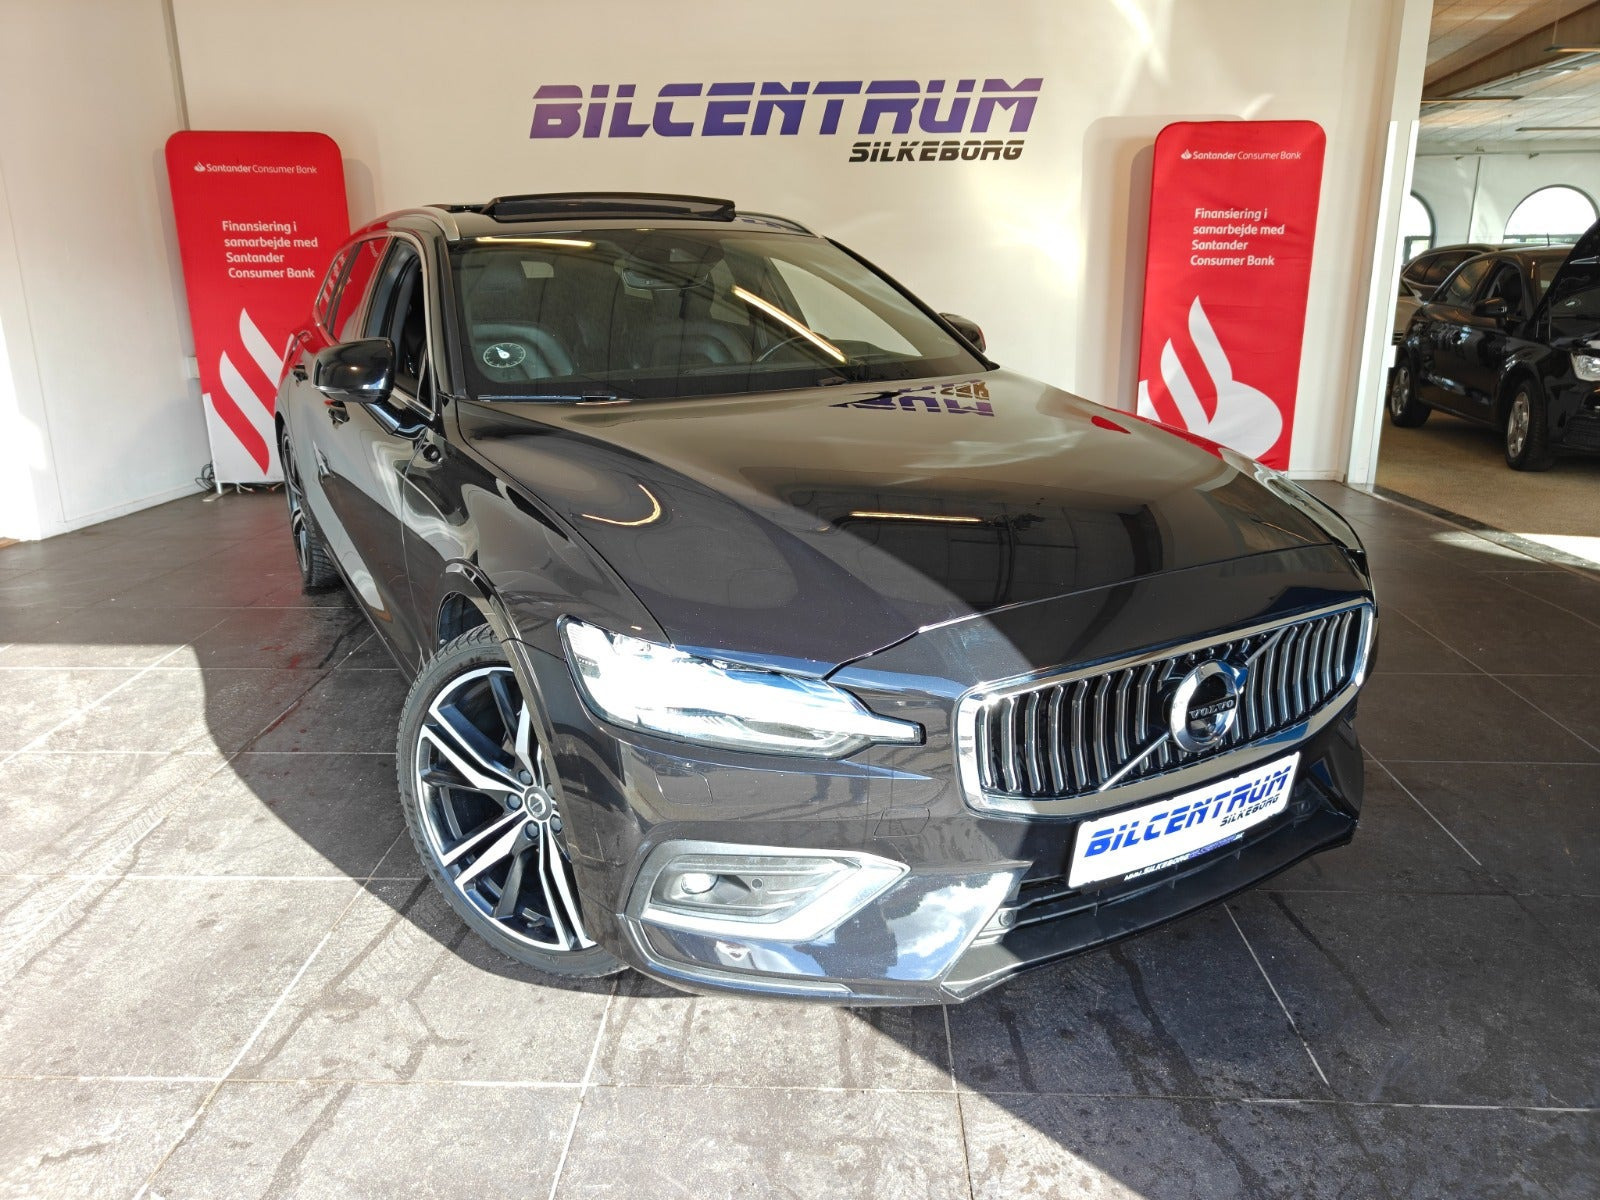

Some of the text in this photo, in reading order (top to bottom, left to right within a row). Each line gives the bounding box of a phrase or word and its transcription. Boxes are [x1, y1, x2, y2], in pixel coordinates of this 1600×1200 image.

[529, 77, 1044, 139] BILCENTRUM
[848, 139, 1025, 163] SILKEBORG
[1192, 151, 1302, 160] Santander Consumer Bank
[206, 163, 318, 174] Santander Consumer Bank
[1194, 208, 1268, 222] Finansiering i
[221, 220, 297, 235] Finansiering i
[1192, 224, 1286, 237] samarbejde med
[224, 236, 319, 250] samarbejde med
[1191, 239, 1249, 251] Santander
[225, 251, 285, 263] Santander
[1189, 254, 1275, 266] Consumer Bank
[228, 267, 316, 278] Consumer Bank
[1188, 699, 1235, 719] VOLVO
[1083, 765, 1292, 858] BILCENTRUM
[1219, 793, 1280, 827] SILKEBORG
